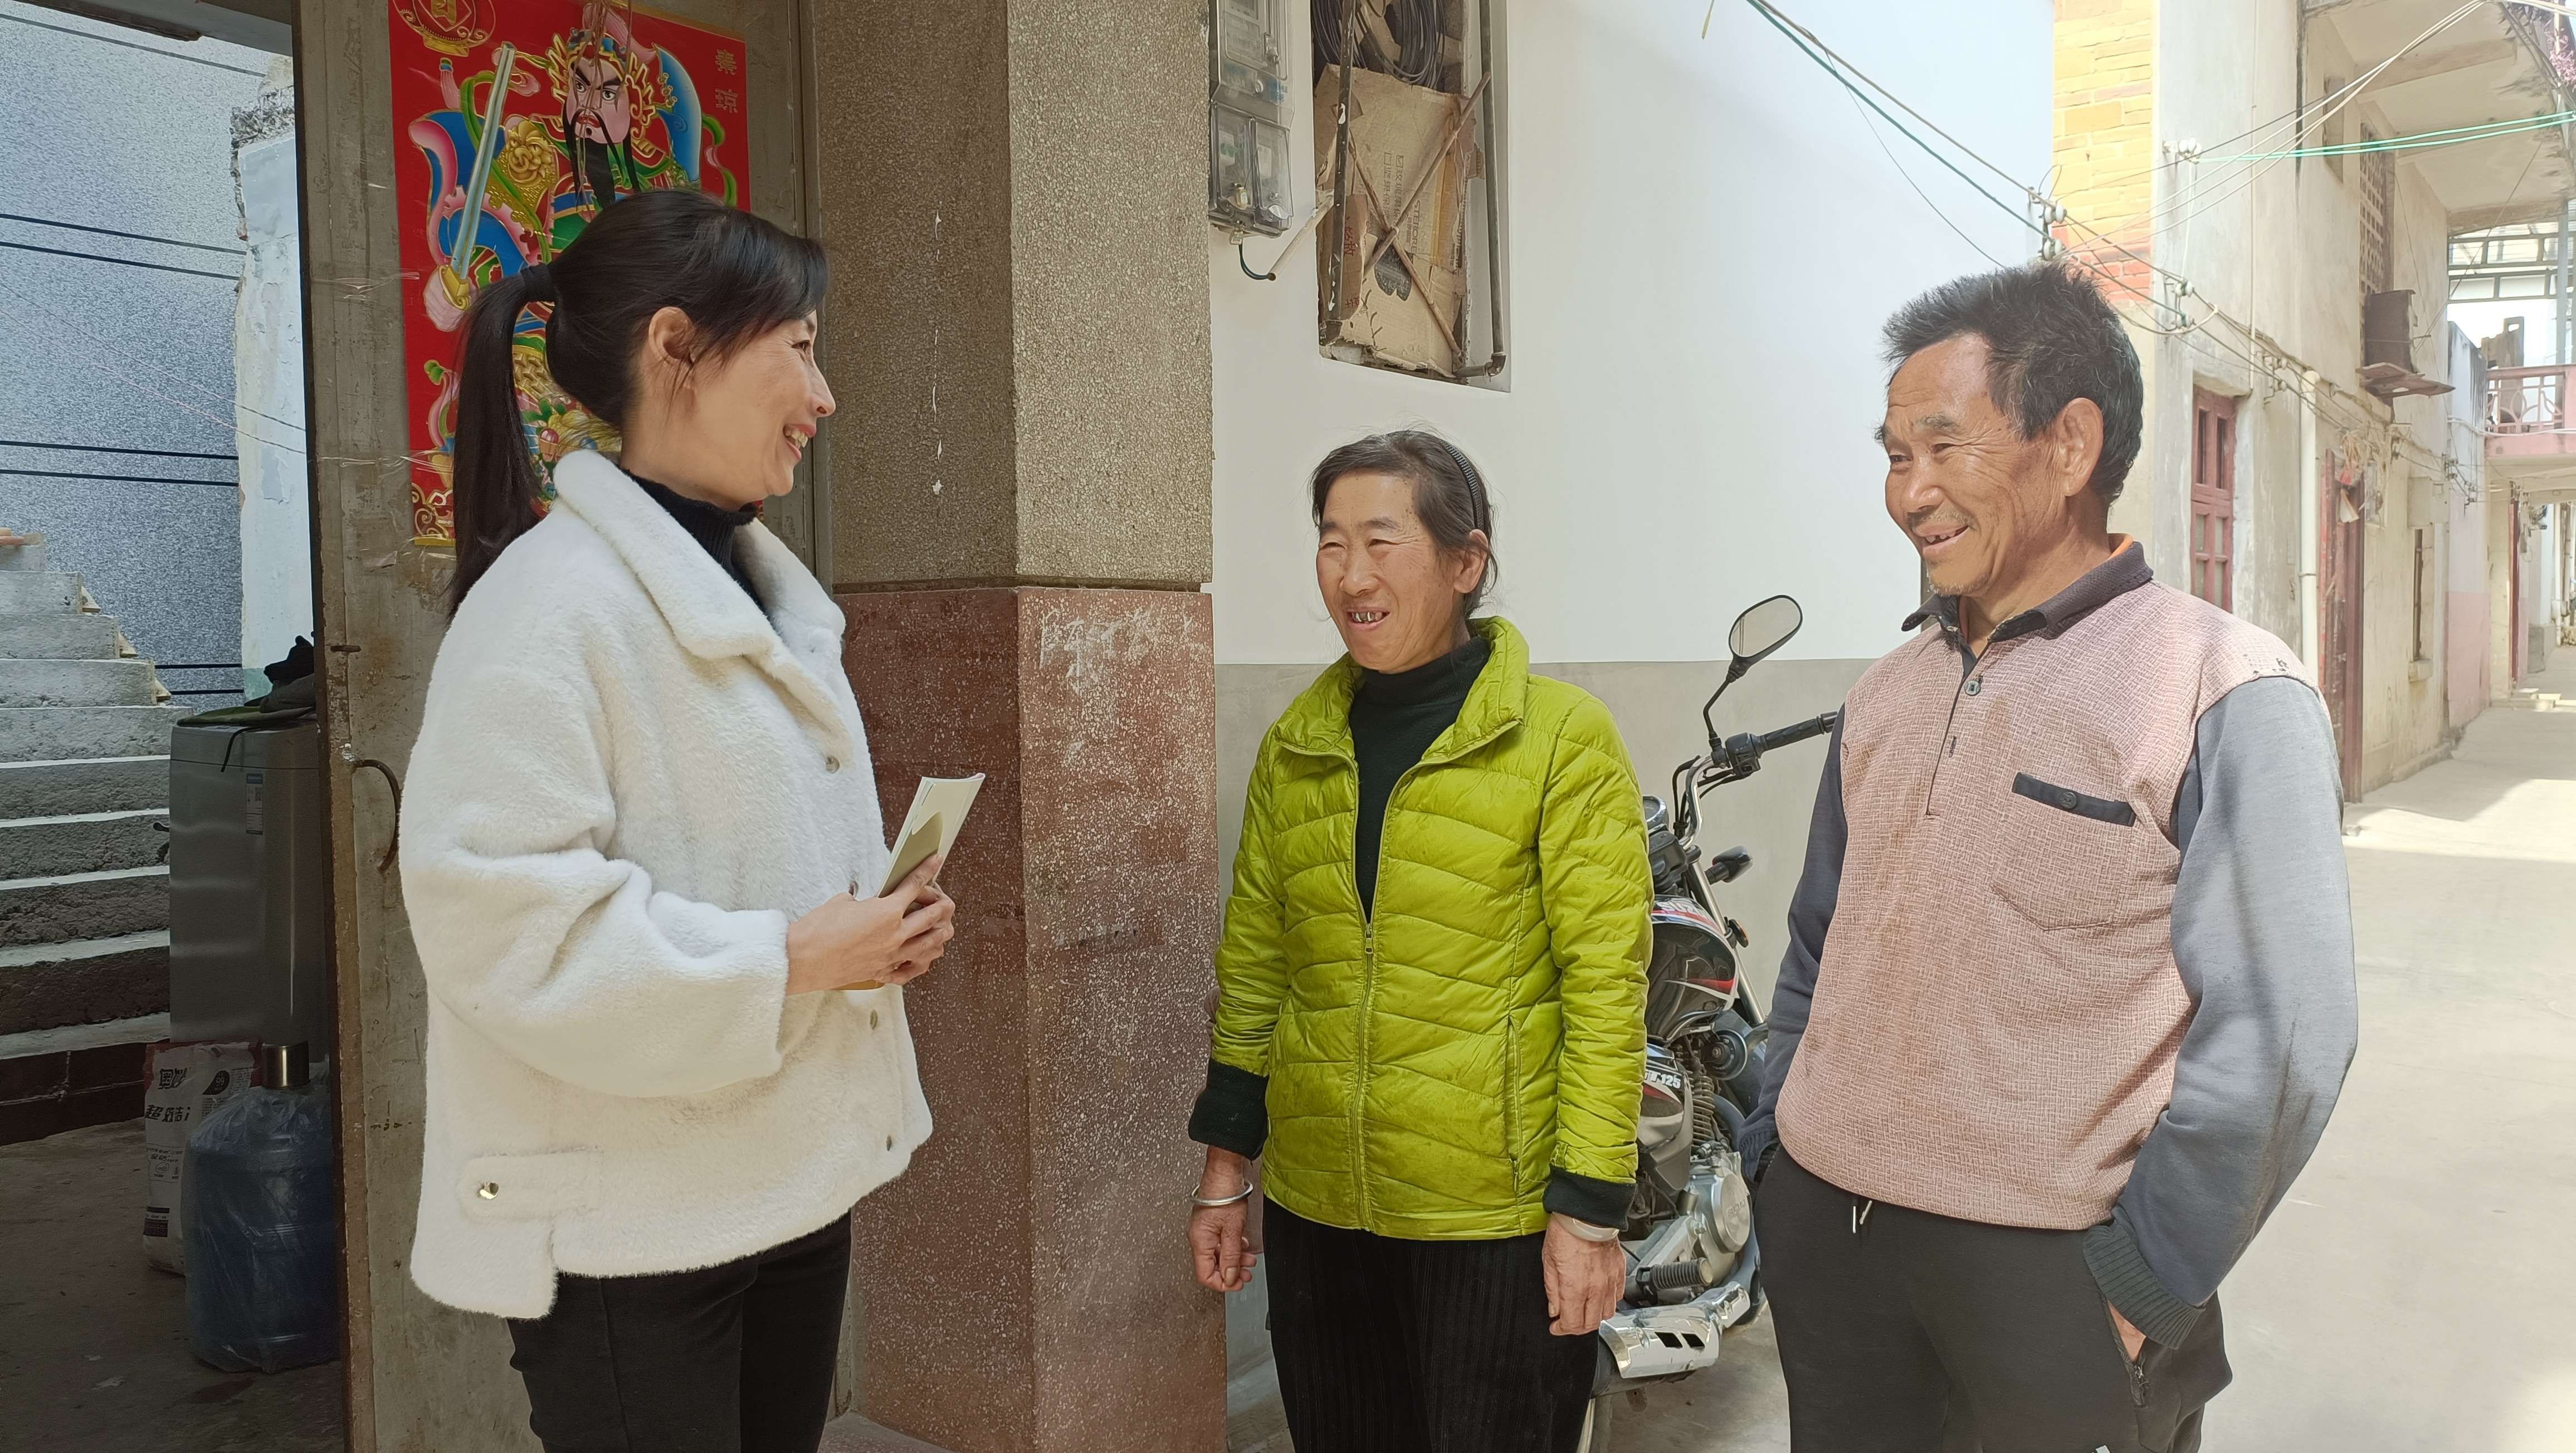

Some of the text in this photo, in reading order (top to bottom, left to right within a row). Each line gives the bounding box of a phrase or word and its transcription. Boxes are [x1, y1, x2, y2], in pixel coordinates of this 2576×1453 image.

[715, 48, 739, 114] 秦琼
[1394, 168, 1403, 226] 玫瑰果保
